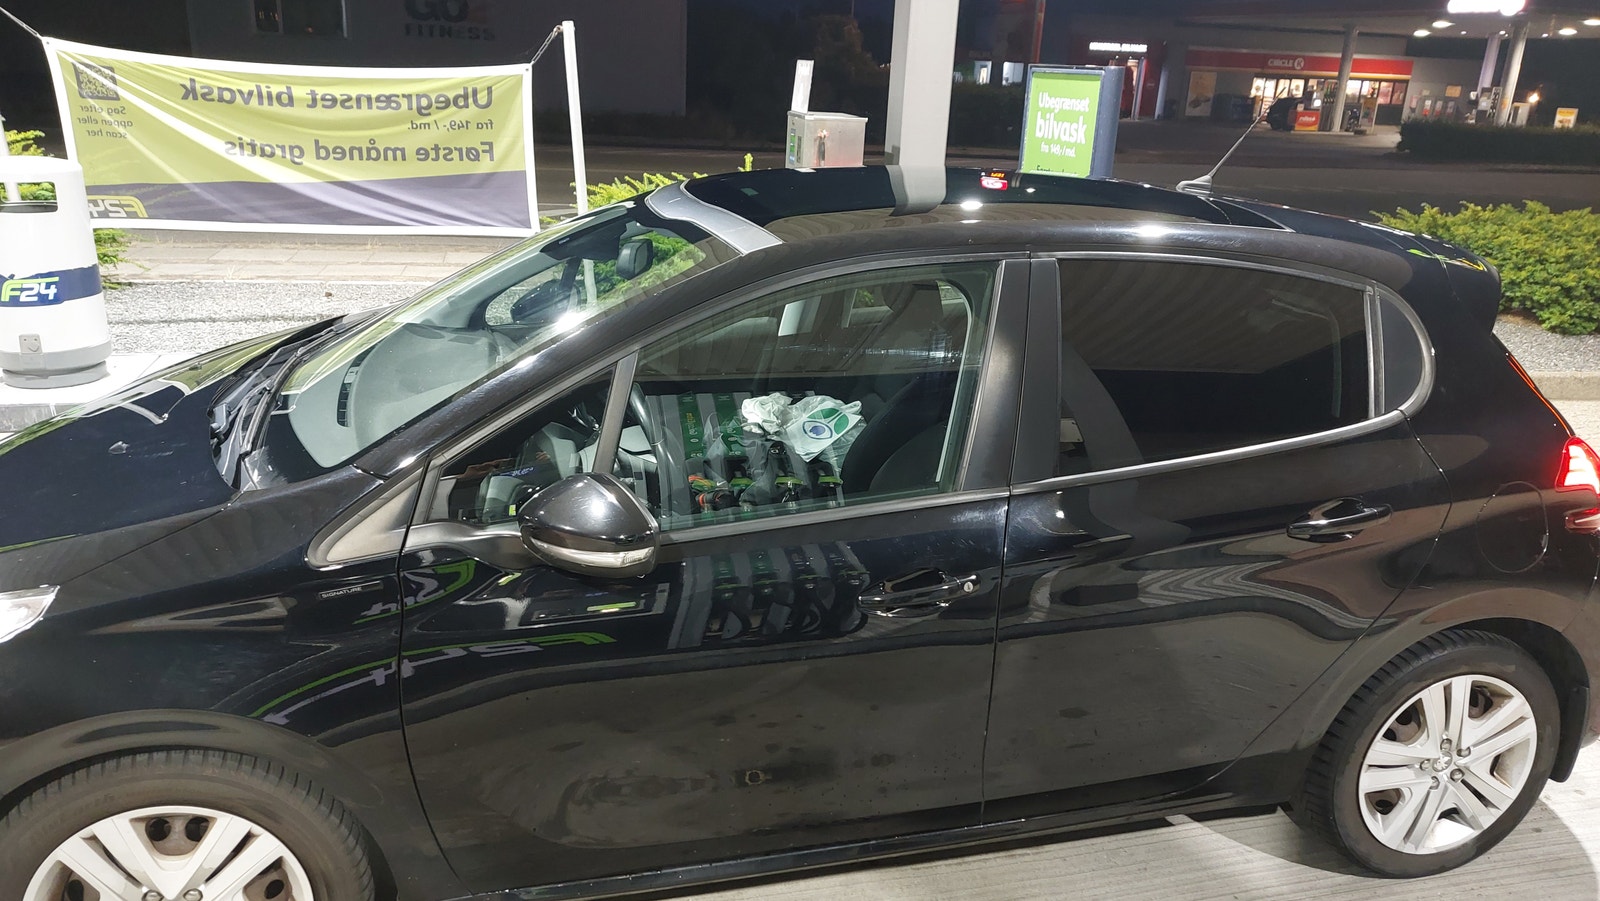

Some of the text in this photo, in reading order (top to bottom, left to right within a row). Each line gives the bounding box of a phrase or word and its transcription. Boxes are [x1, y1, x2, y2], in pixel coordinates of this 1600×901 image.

[404, 23, 495, 41] FITNESS
[1268, 57, 1305, 70] CIRCLE K
[1038, 91, 1090, 113] Ubegrænset
[1035, 111, 1087, 144] bilvask
[1, 276, 60, 302] F24
[321, 586, 363, 598] SIGNATURE
